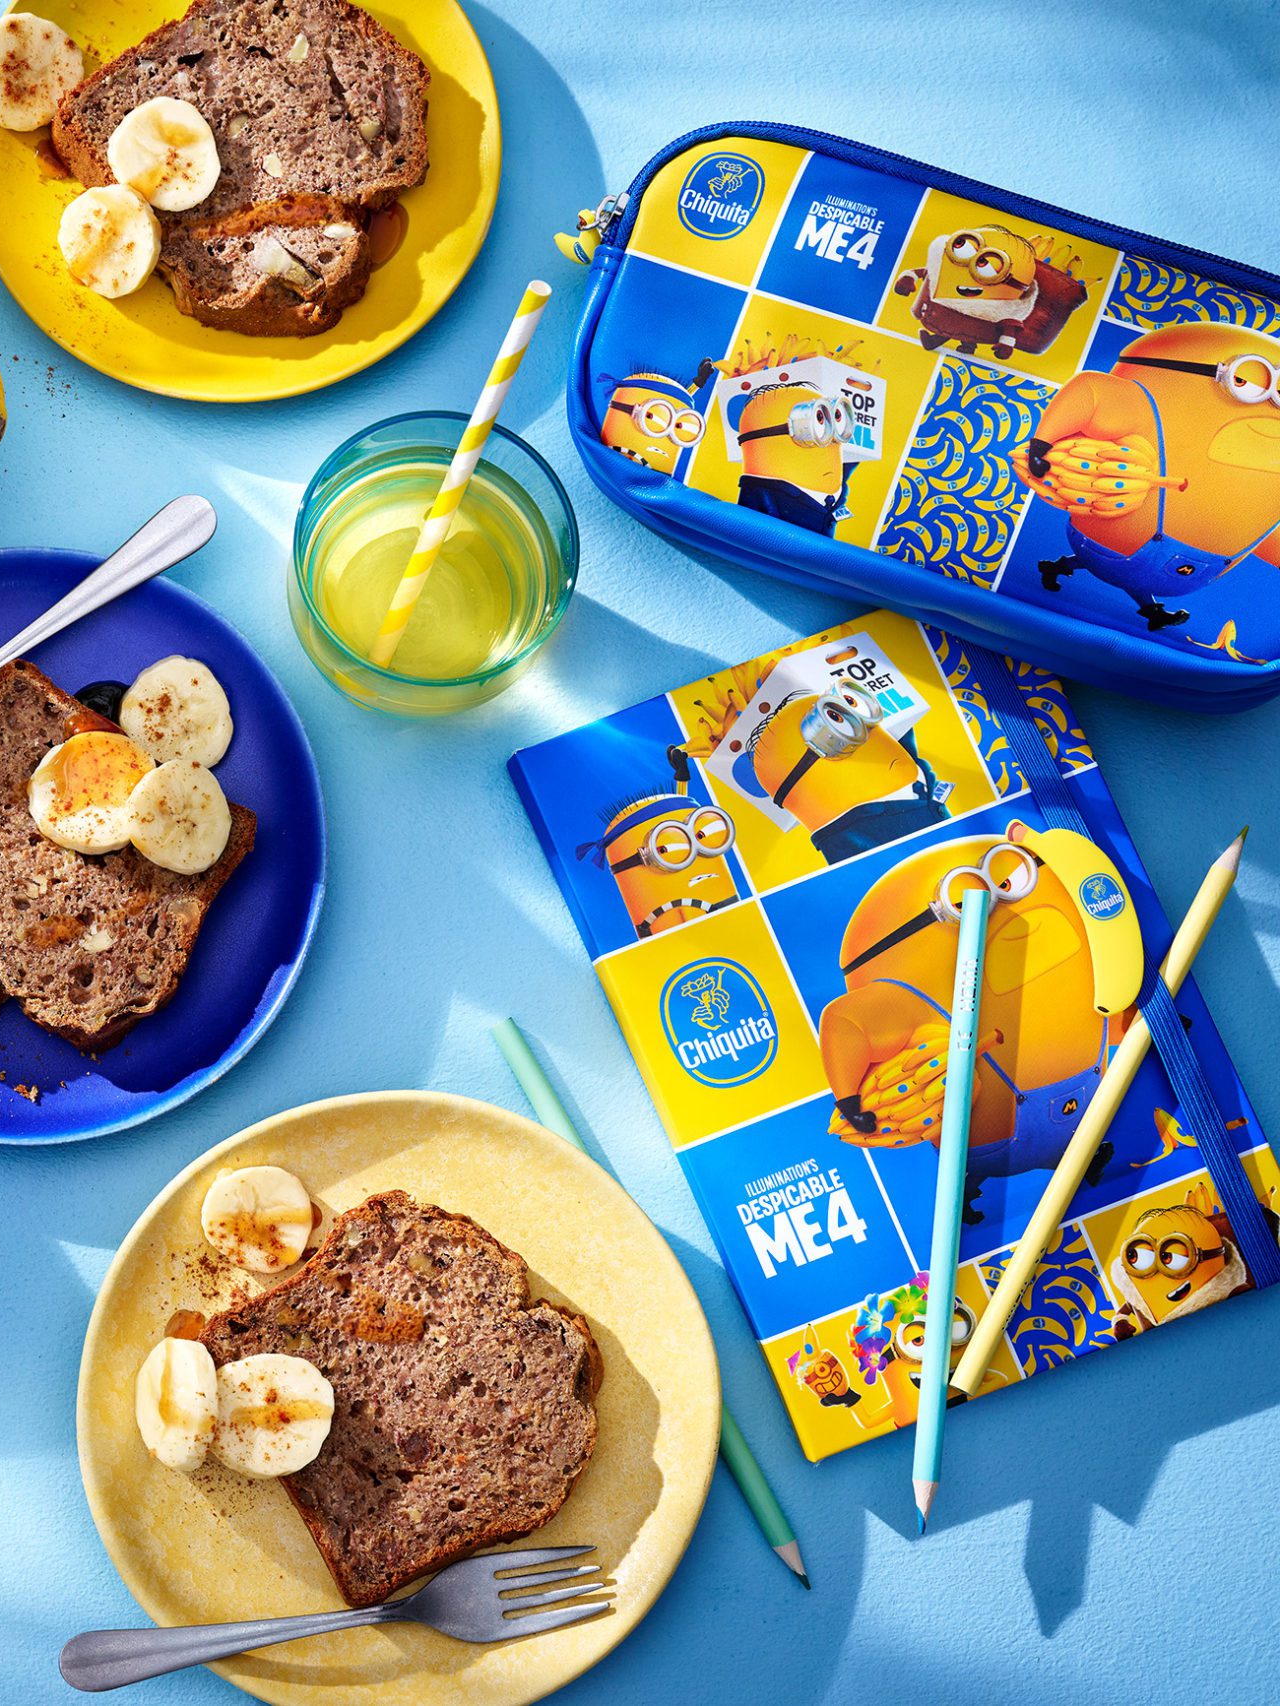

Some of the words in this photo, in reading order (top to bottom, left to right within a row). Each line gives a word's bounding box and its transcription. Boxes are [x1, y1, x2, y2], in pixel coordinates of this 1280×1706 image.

[679, 189, 751, 226] Chiquita
[809, 201, 885, 234] DESPICABLE
[825, 194, 878, 217] ILLUMINATION'S
[1087, 893, 1124, 915] Chiquita
[677, 1016, 776, 1069] Chiquita
[736, 1167, 845, 1226] DESPICABLE
[744, 1158, 819, 1198] ILLUMINATION'S
